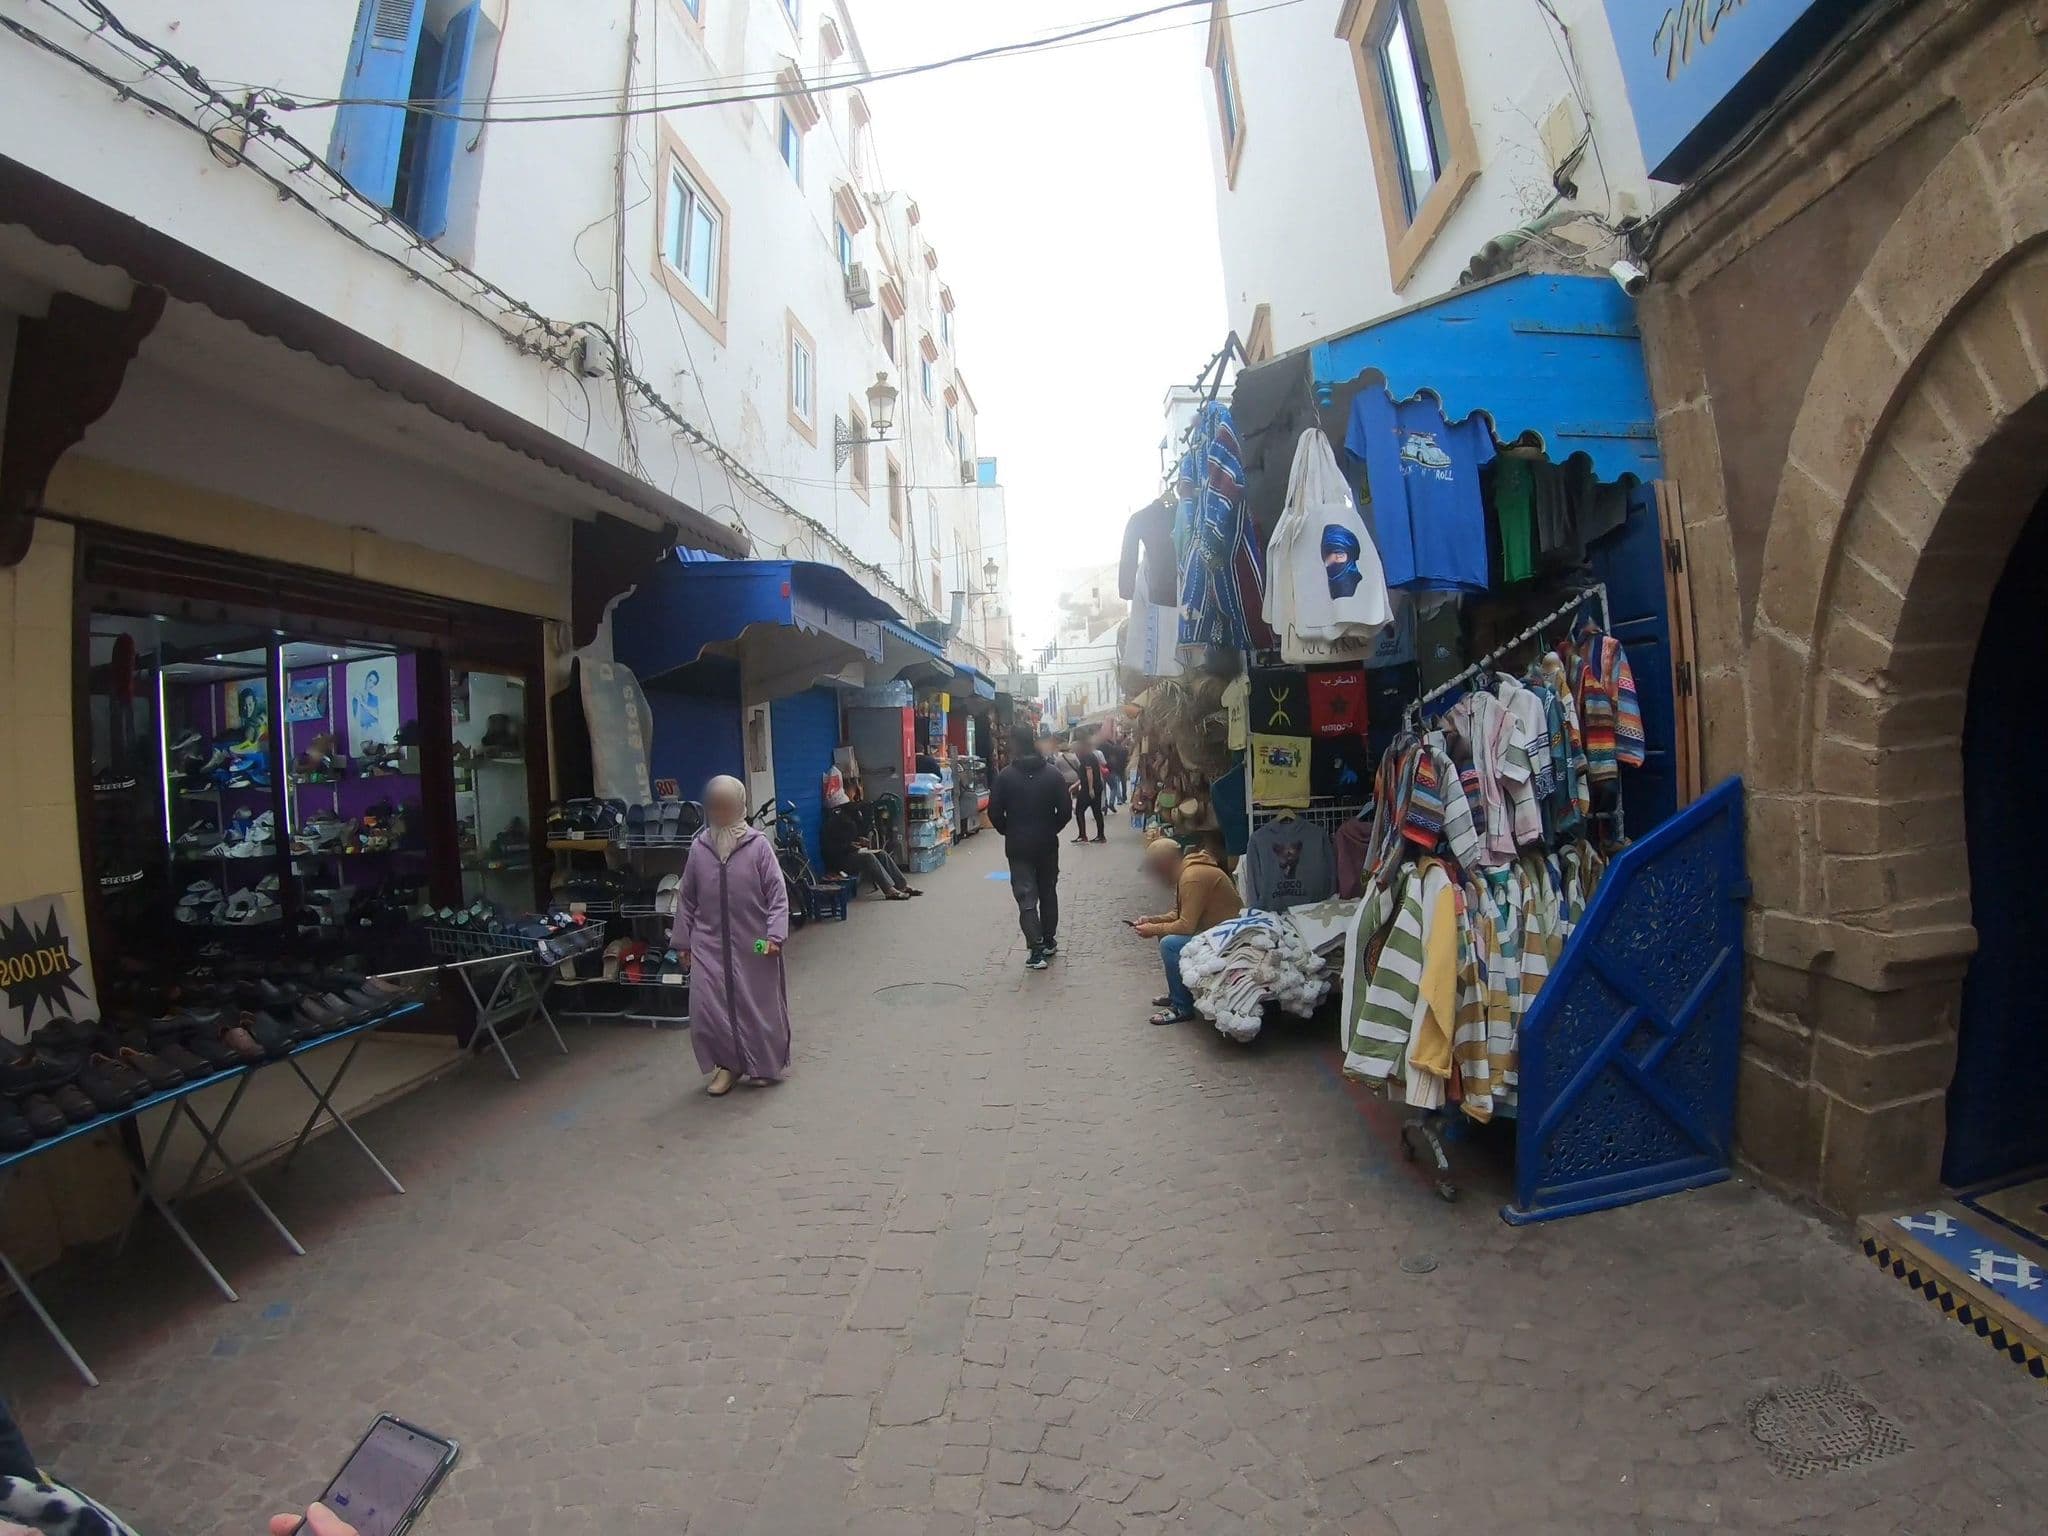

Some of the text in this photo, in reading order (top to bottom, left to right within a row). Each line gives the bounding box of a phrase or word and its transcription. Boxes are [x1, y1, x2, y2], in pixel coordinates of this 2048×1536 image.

[1435, 469, 1454, 481] ROLL
[1320, 675, 1357, 687] المغرب
[0, 945, 71, 986] 200 DH
